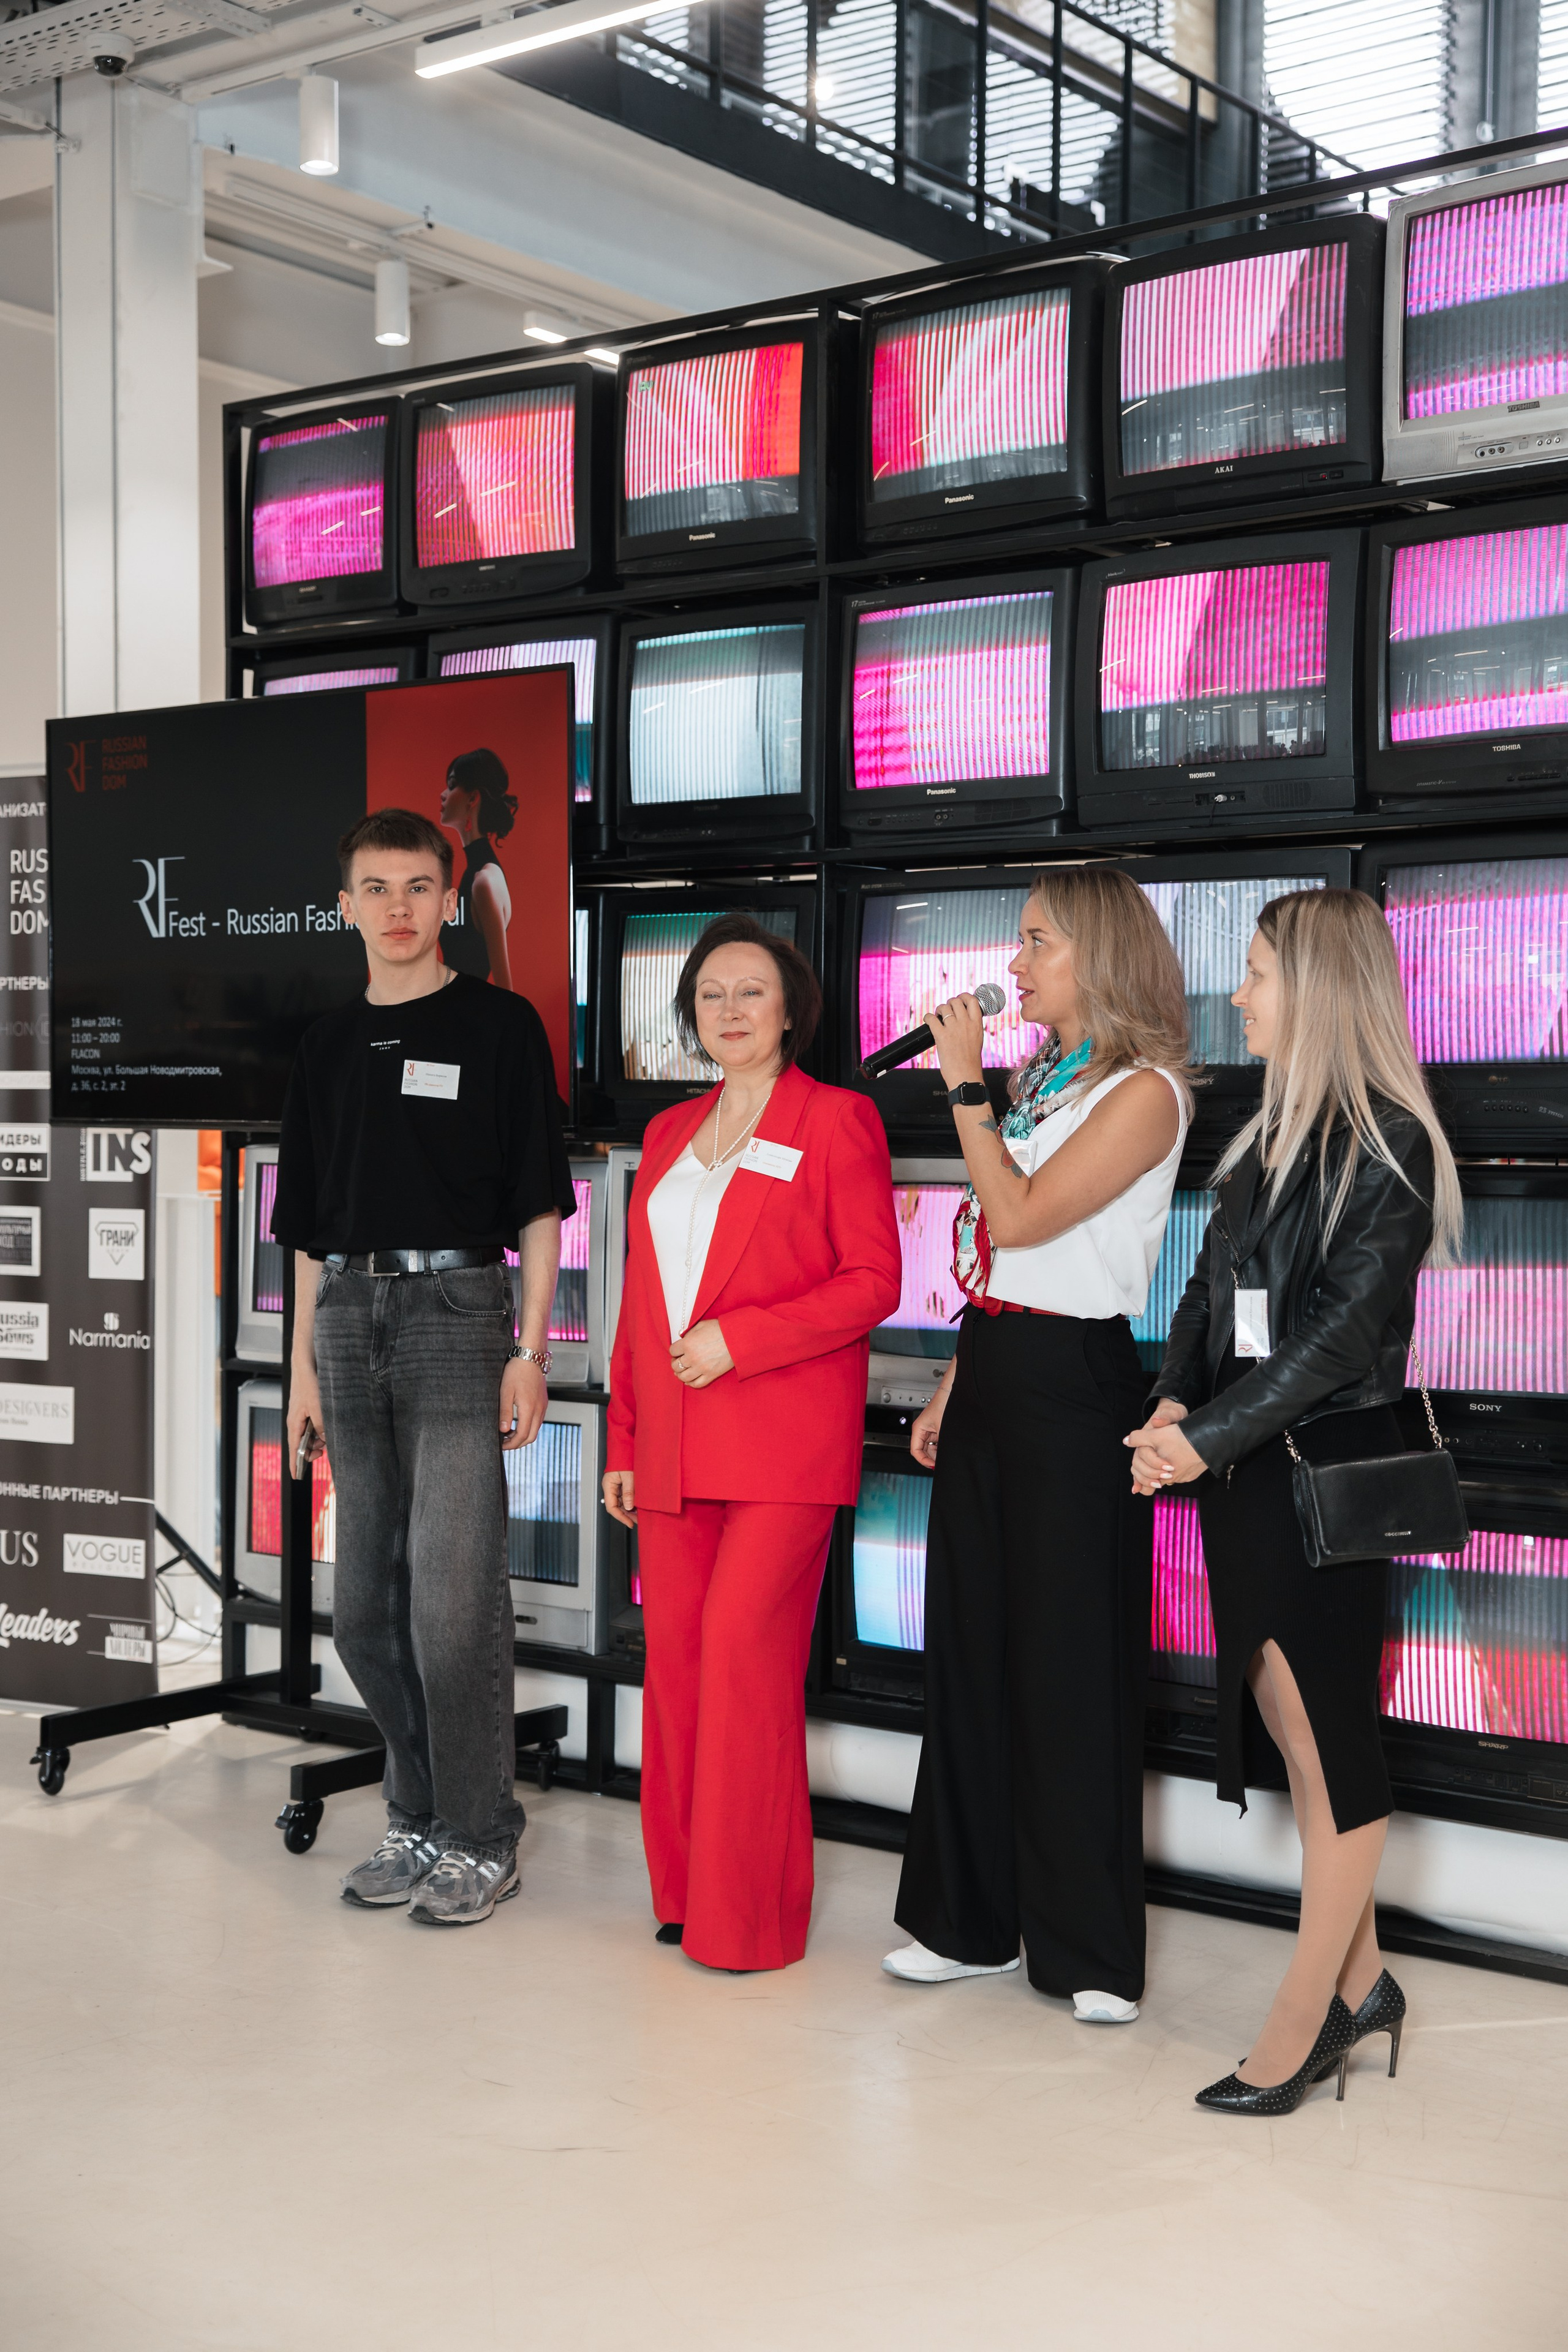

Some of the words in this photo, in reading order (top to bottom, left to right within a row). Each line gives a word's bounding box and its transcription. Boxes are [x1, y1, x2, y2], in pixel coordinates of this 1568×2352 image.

[1508, 401, 1540, 412] TOSHIBA
[1215, 466, 1233, 474] AKAI
[945, 494, 974, 503] Panasonic
[689, 532, 715, 541] Panasonic
[102, 735, 147, 753] RUSSIAN
[1493, 744, 1521, 752] TOSHIBA
[102, 753, 148, 772] FASHION
[102, 774, 127, 791] DOM
[0, 802, 46, 818] НИЗАТ
[169, 911, 206, 937] Fest
[227, 908, 298, 935] Russian
[306, 902, 360, 932] Fash
[71, 1017, 80, 1027] 18
[97, 1017, 116, 1027] 2024
[71, 1033, 91, 1043] 11:00
[99, 1033, 121, 1043] 20:00
[71, 1048, 100, 1059] FLACON
[71, 1065, 102, 1076] Москва,
[103, 1066, 113, 1077] ул.
[115, 1065, 149, 1075] Большая
[150, 1065, 222, 1077] Новодмитровская,
[80, 1080, 91, 1091] 36,
[101, 1080, 108, 1091] 2,
[120, 1080, 126, 1091] 2
[1547, 1110, 1564, 1119] SYSTEM
[100, 1229, 135, 1246] ГРАНИ
[69, 1328, 151, 1350] Narmania
[1470, 1403, 1502, 1412] SONY
[42, 1485, 119, 1505] ПАРТНЕРЫ
[67, 1540, 142, 1566] VOGUE
[1478, 1741, 1509, 1750] SHARP
